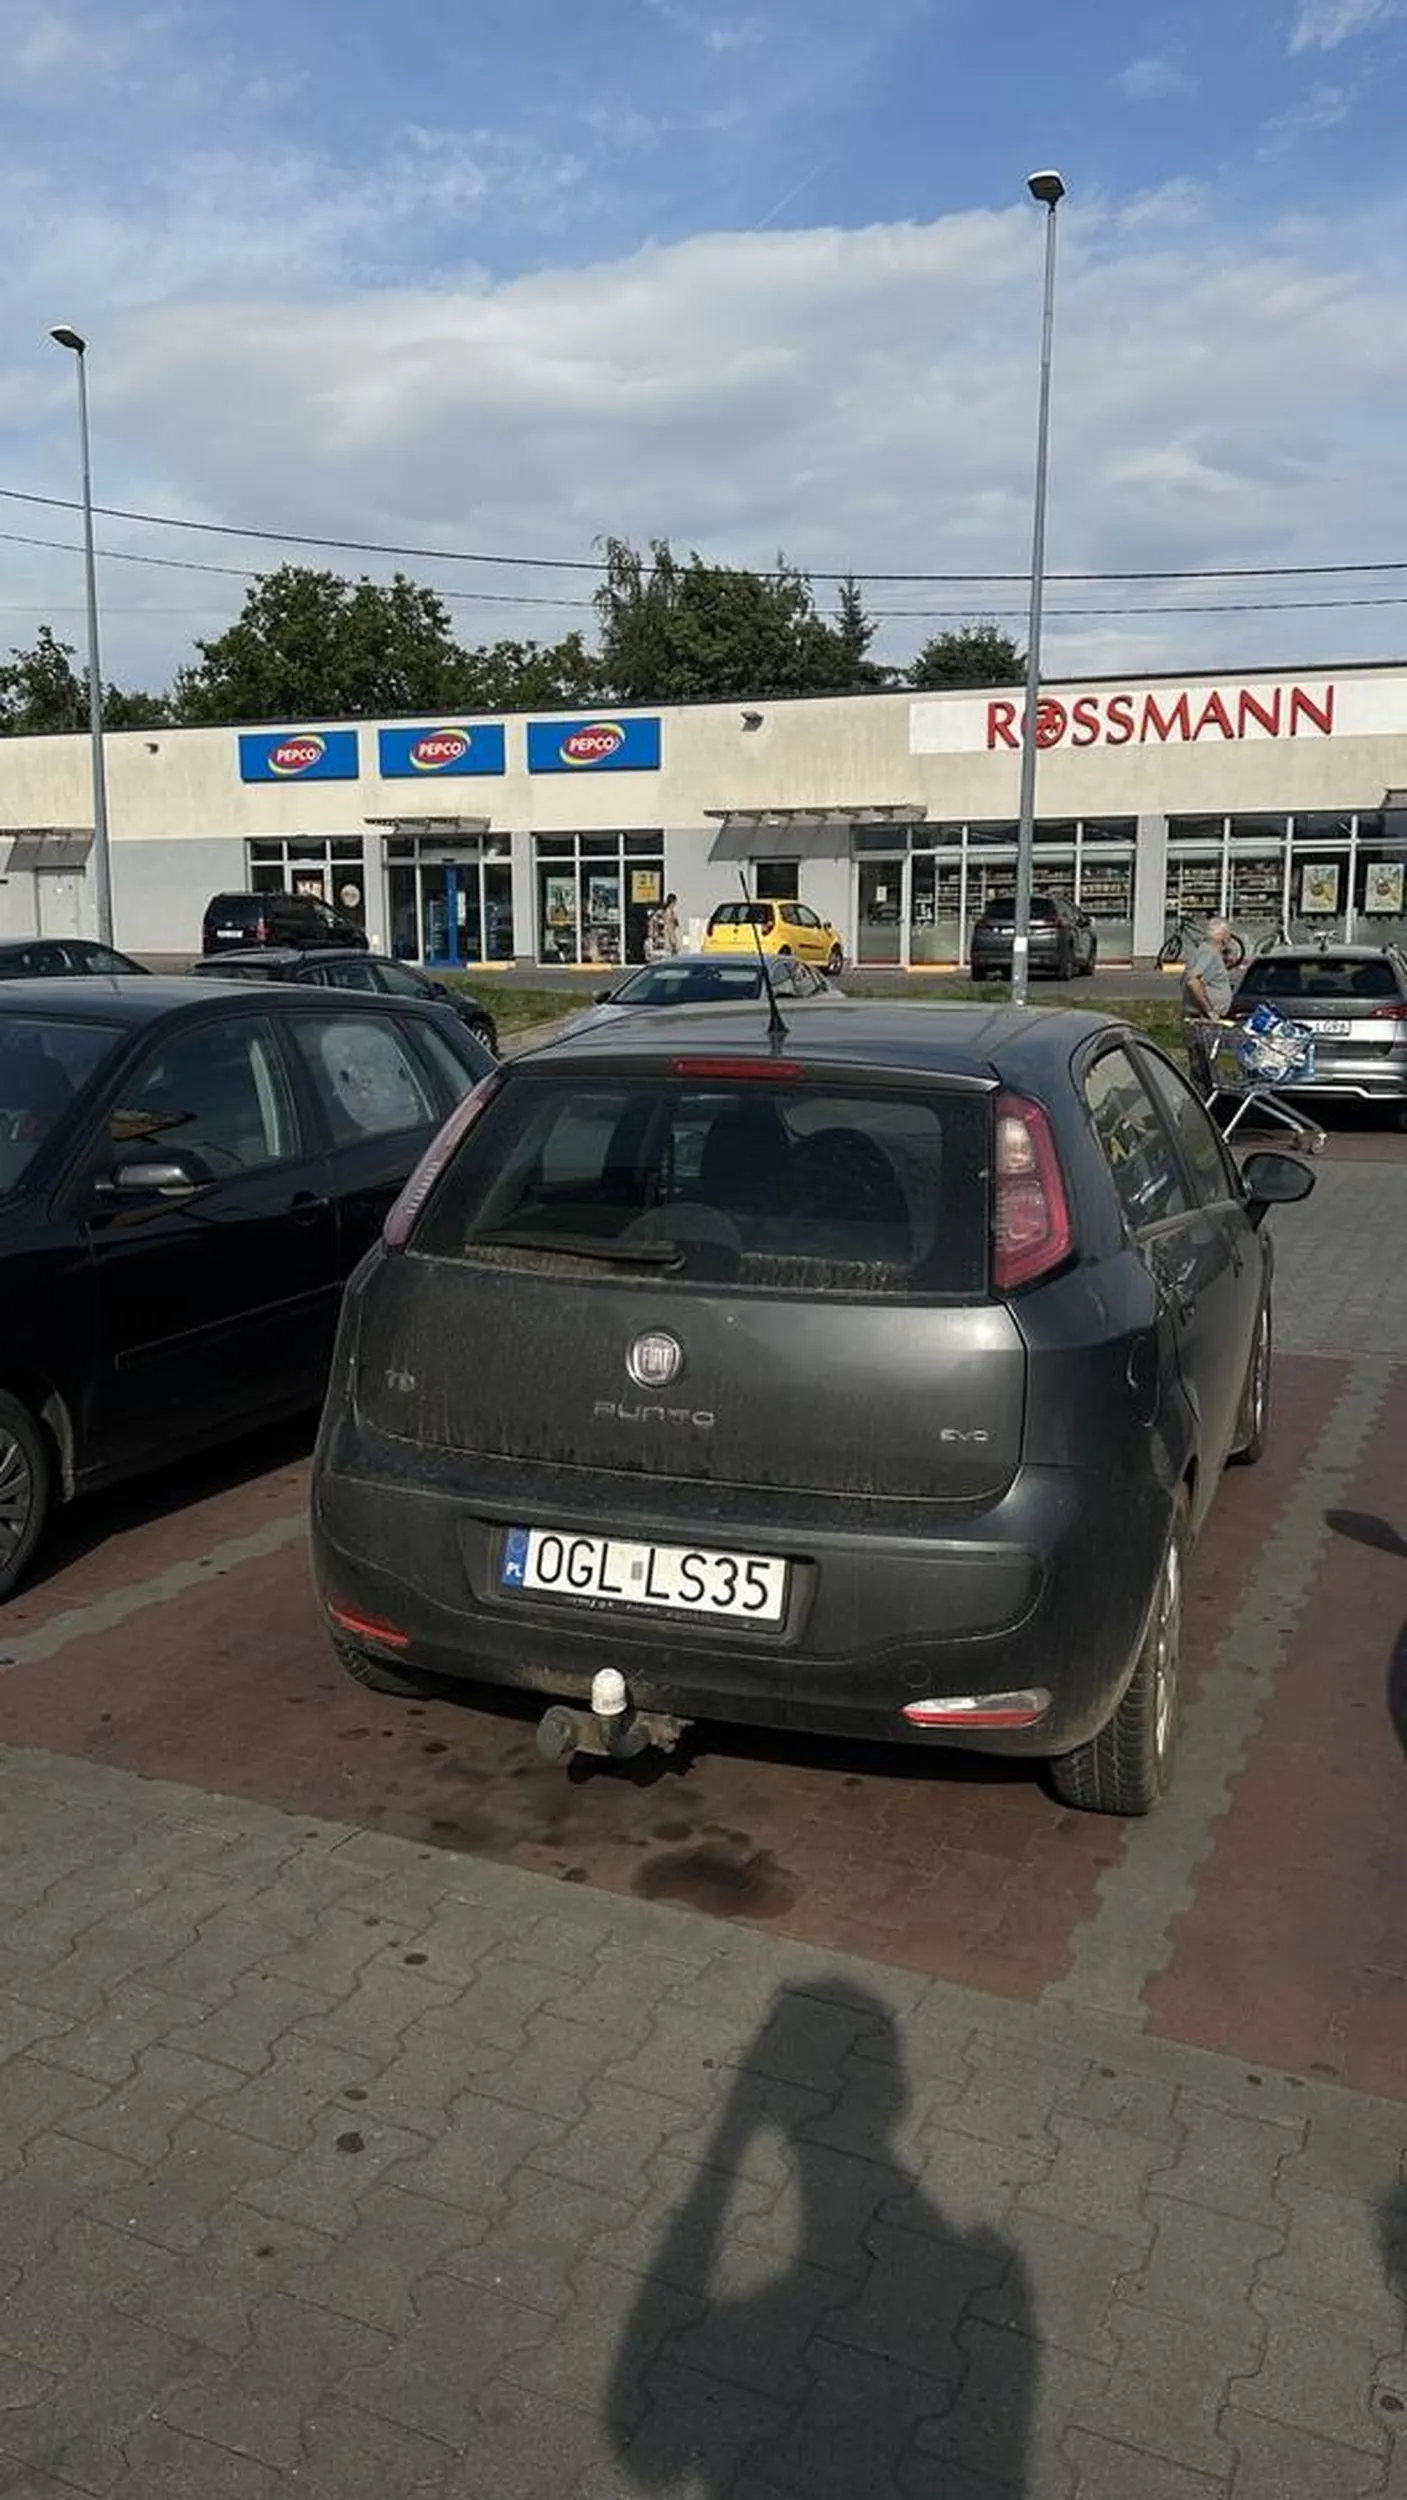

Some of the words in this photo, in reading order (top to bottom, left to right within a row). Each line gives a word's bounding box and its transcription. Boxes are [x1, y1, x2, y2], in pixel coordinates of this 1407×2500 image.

[987, 685, 1334, 750] ROSSMANN
[418, 741, 462, 757] PEPCO
[569, 736, 615, 752] PEPCO
[277, 747, 317, 762] PEPCO
[593, 1399, 715, 1428] PUNTO
[506, 1562, 522, 1577] PL
[535, 1535, 623, 1594] OGL
[645, 1546, 771, 1611] LS35
